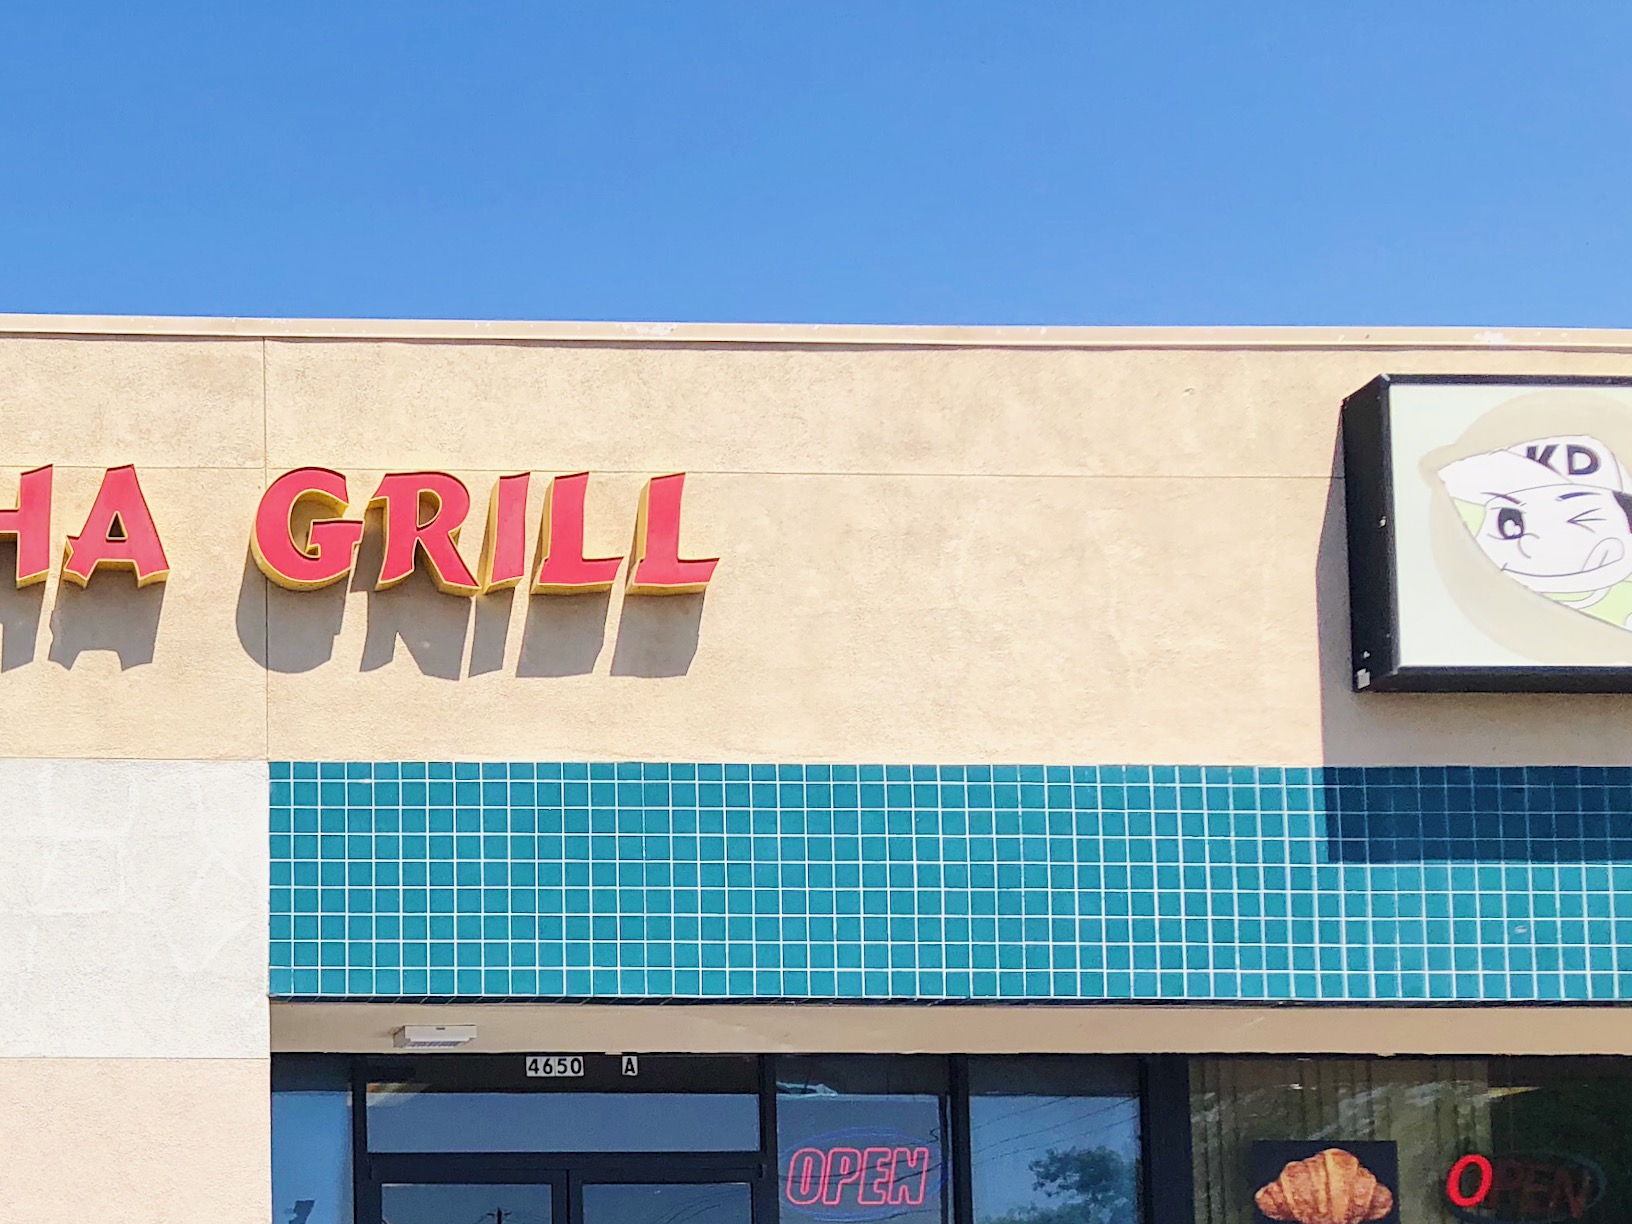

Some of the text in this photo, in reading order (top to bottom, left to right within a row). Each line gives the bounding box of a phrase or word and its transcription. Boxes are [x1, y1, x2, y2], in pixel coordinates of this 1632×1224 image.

[1526, 443, 1601, 475] KD
[250, 466, 721, 596] GRILL
[528, 1057, 636, 1075] 4650 A
[786, 1147, 930, 1206] OPEN
